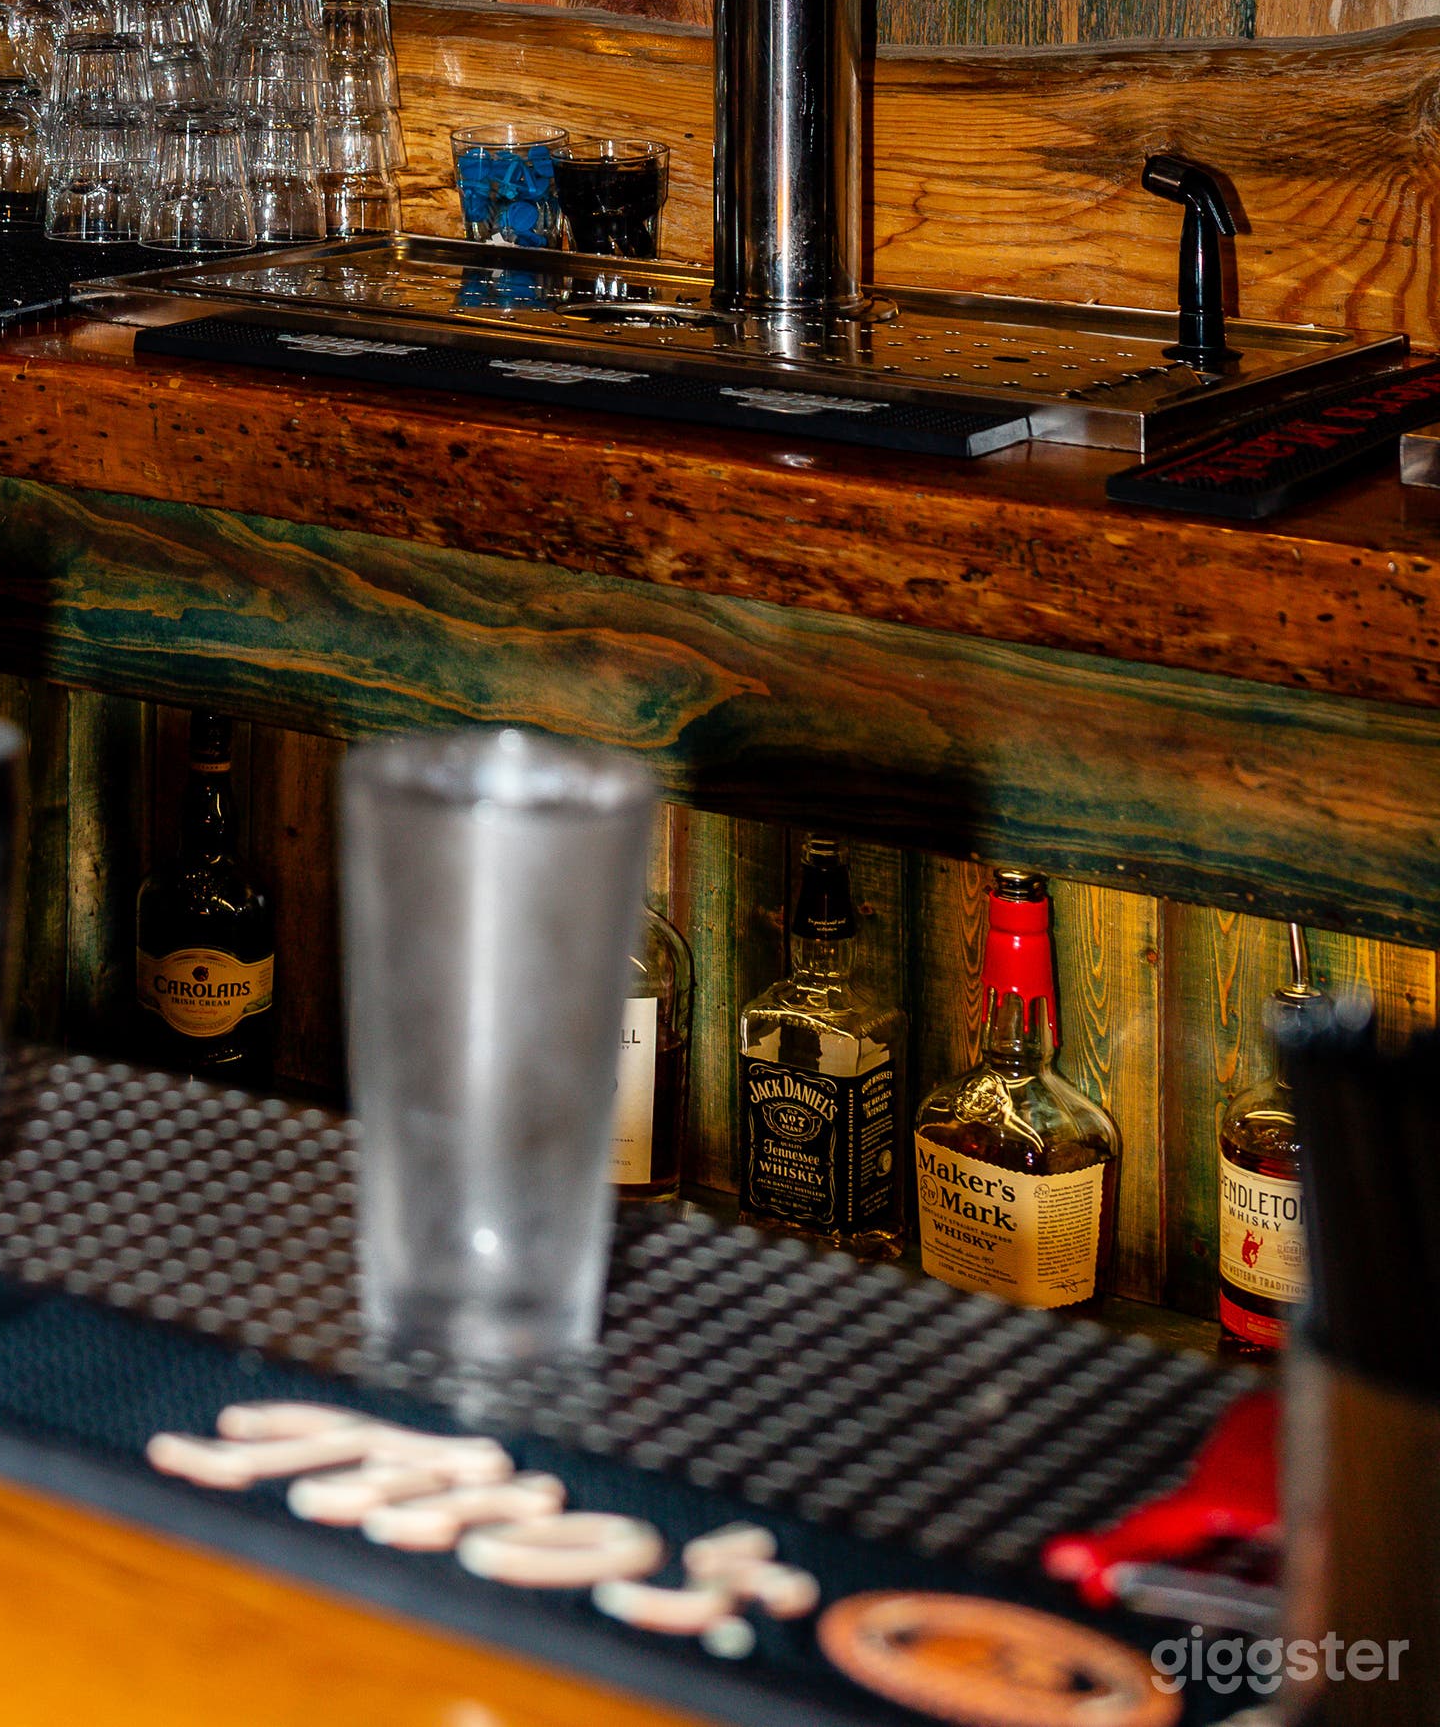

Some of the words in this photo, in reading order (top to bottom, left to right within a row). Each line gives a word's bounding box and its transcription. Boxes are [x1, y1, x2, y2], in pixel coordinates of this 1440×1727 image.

[153, 975, 252, 998] CAROLANS
[171, 996, 195, 1006] IRISH
[198, 999, 231, 1007] CREAM
[748, 1078, 783, 1104] JACK
[783, 1074, 839, 1122] DANIEL'S
[763, 1138, 820, 1165] Tennessee
[759, 1160, 825, 1186] WHISKEY
[918, 1147, 1016, 1203] Maker's
[939, 1185, 1016, 1232] Mark
[1228, 1204, 1282, 1233] WHISKY
[932, 1219, 997, 1252] WHISKY
[1229, 1264, 1257, 1285] WESTERN
